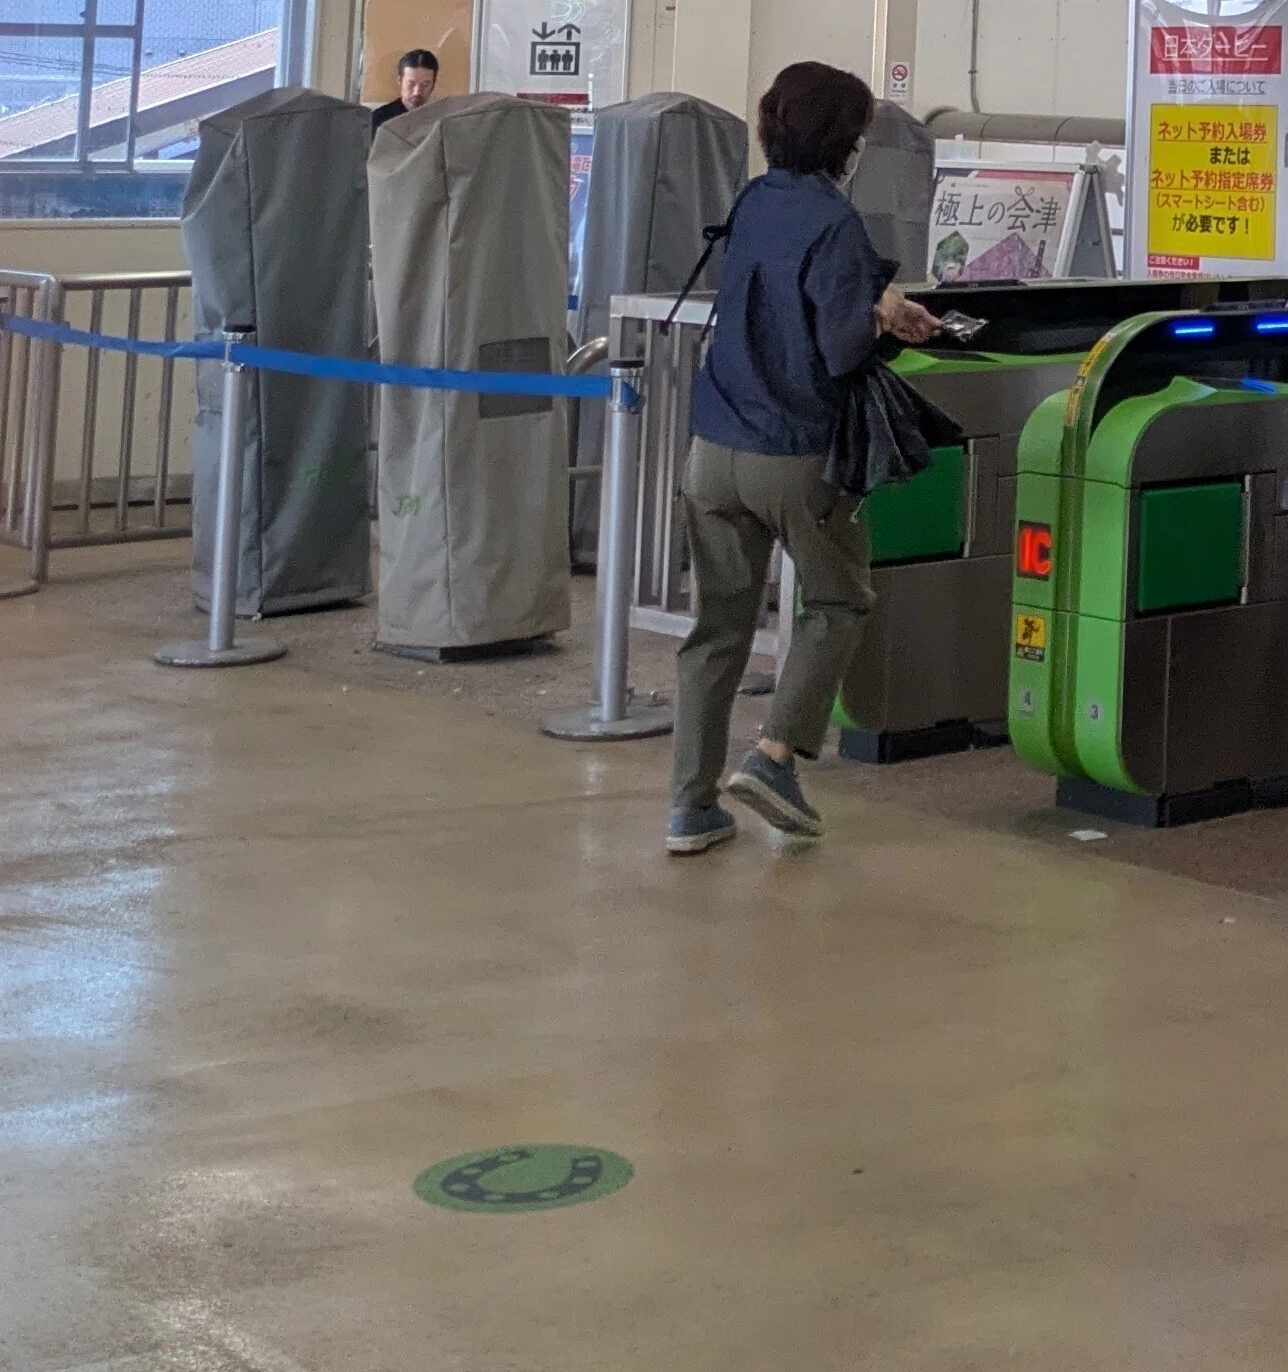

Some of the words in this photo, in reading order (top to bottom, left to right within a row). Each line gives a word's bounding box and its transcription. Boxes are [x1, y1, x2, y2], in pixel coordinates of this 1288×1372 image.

[1163, 32, 1268, 59] 日本ダービー
[1168, 79, 1266, 94] 当日のご入場について
[1157, 121, 1269, 141] ネット予約入場券
[1209, 147, 1252, 166] または
[1151, 169, 1275, 190] ネット予約指定席券
[934, 185, 1062, 233] 極上の会津
